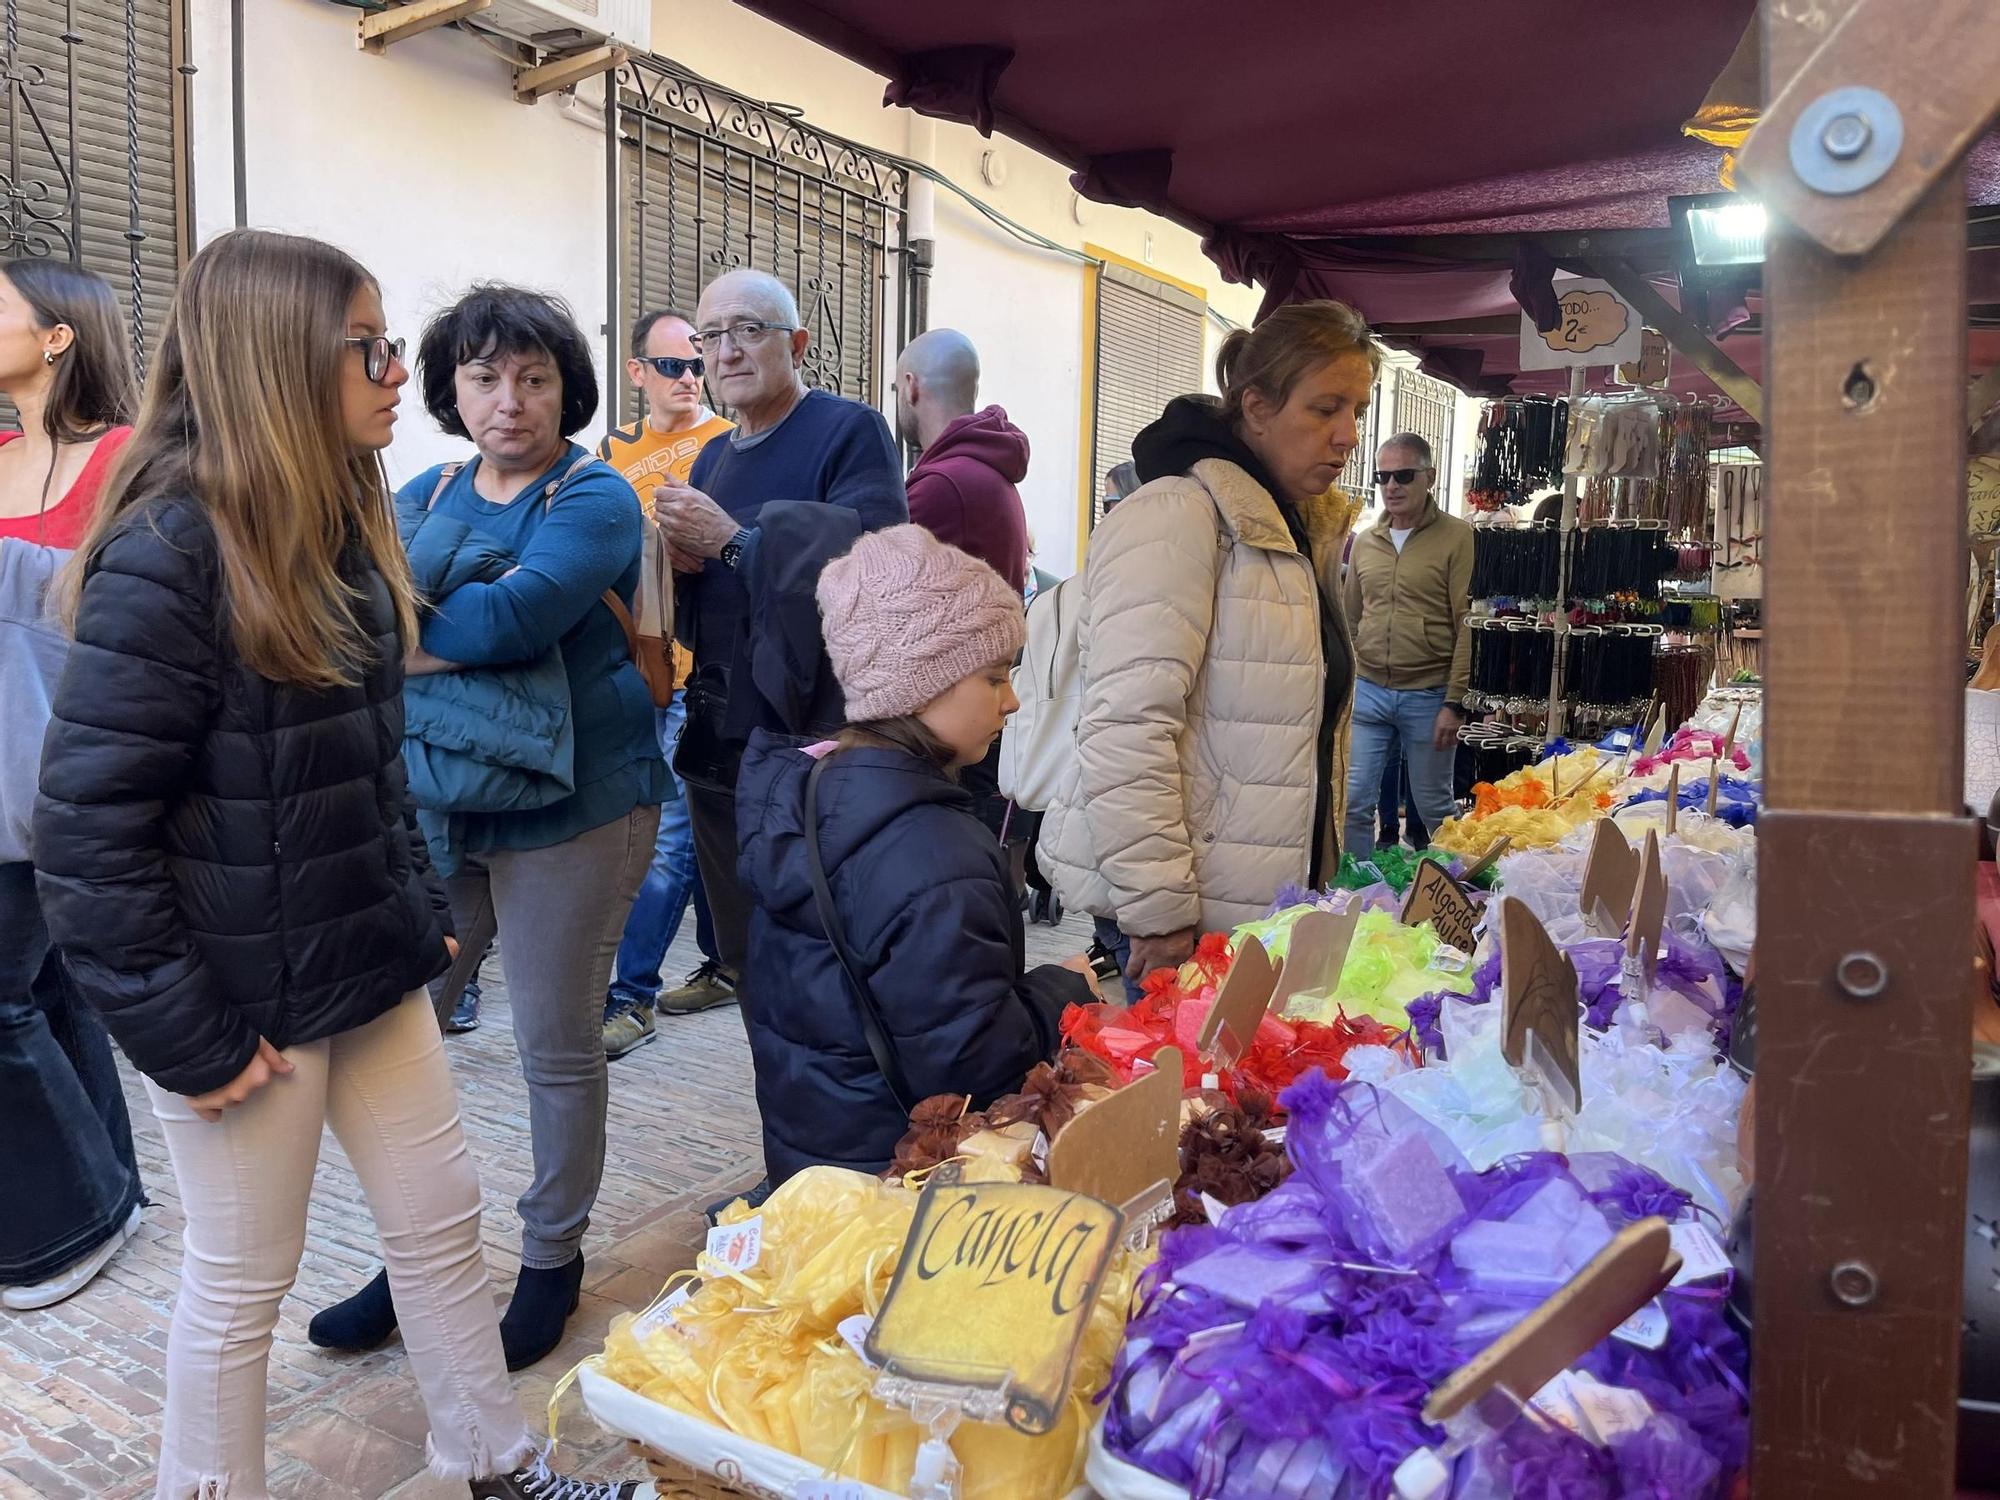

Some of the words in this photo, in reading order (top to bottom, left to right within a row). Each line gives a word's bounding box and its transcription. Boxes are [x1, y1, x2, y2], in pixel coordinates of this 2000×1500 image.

[1565, 319, 1589, 343] 2€
[1431, 912, 1469, 953] dulce
[917, 1191, 1098, 1316] Canela
